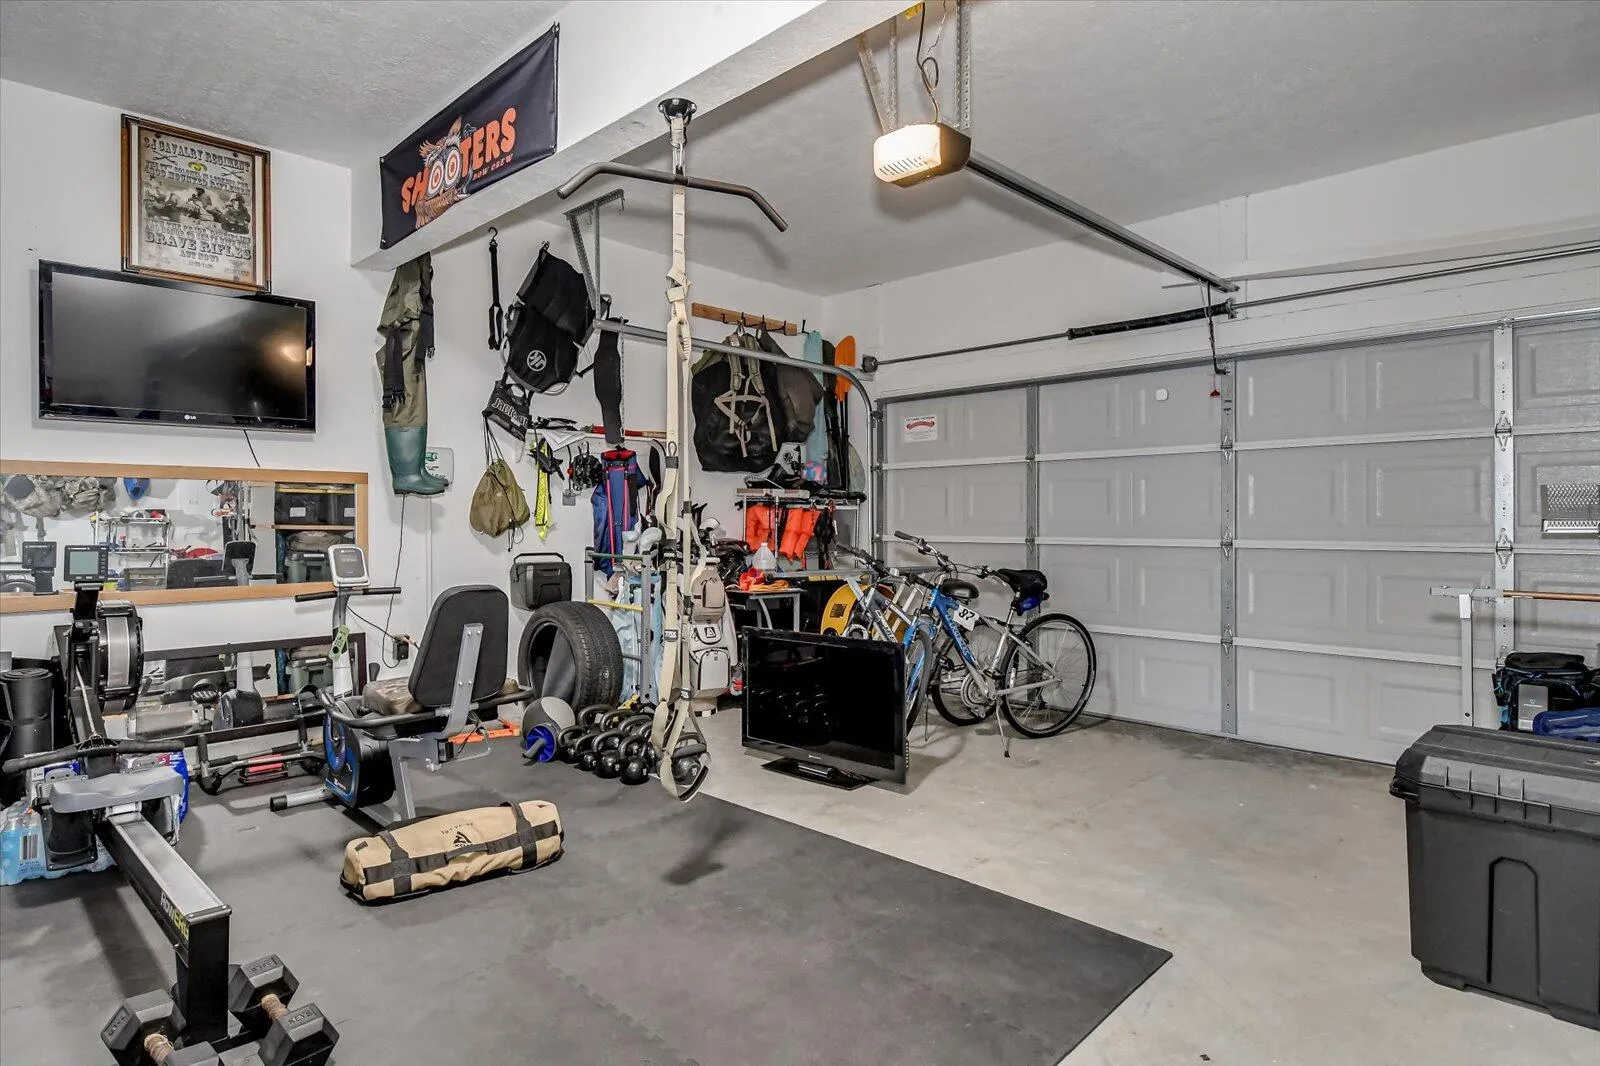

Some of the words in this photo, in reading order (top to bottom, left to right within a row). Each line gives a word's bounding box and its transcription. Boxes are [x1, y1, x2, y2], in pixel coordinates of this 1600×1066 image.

[158, 141, 202, 161] CAVALRY
[205, 152, 249, 171] REGIMENT
[401, 108, 516, 213] SHOOTERS
[491, 153, 513, 170] CREW
[168, 172, 207, 186] MOUNTED
[145, 230, 196, 250] BRAVE
[200, 241, 250, 260] RIFLES
